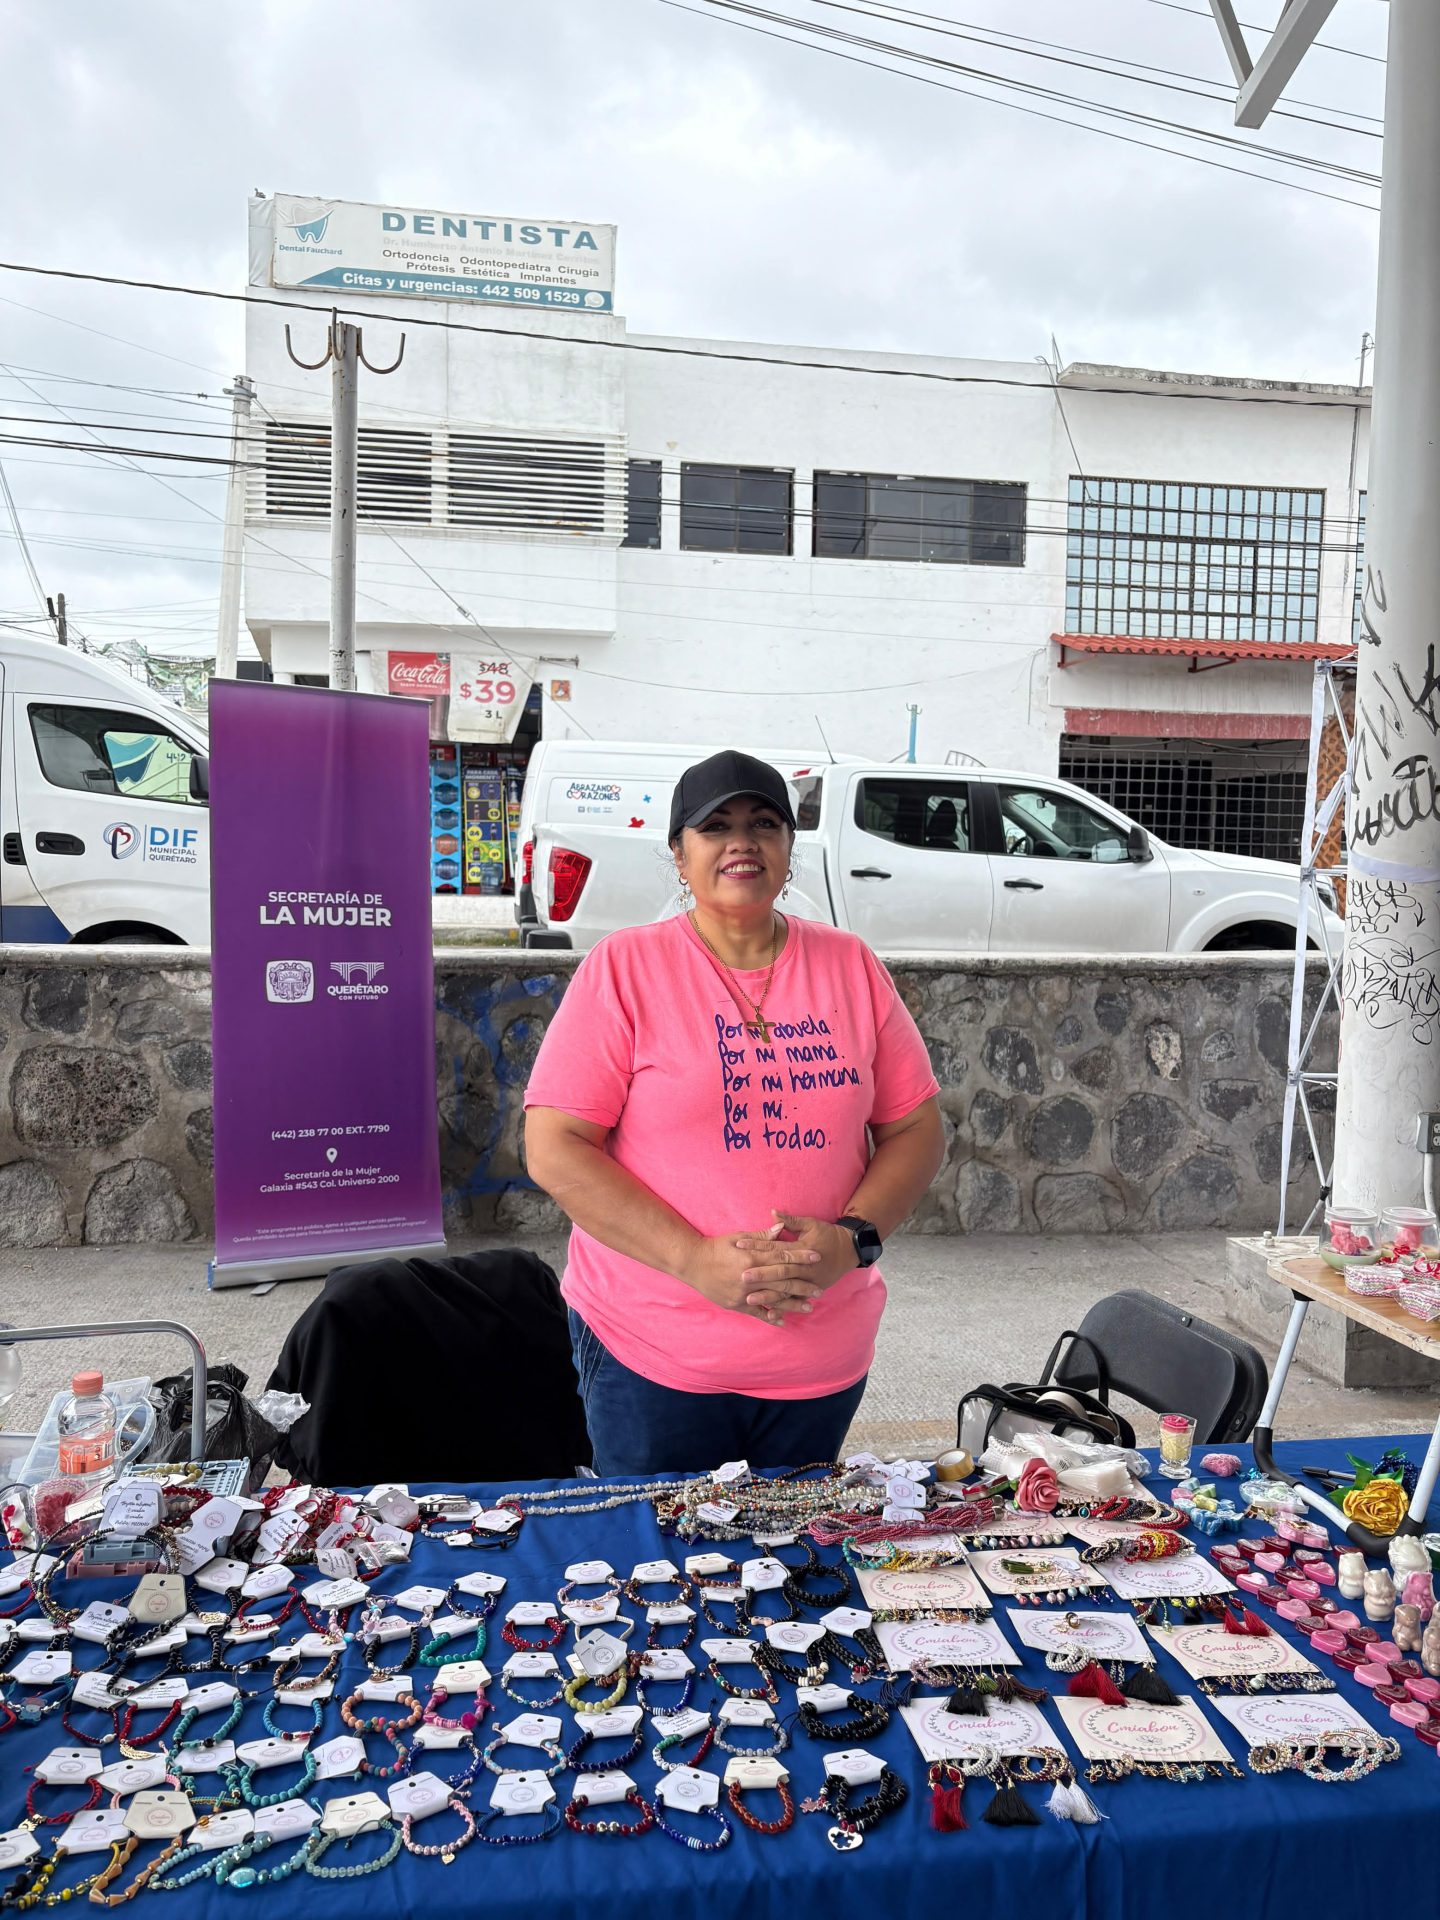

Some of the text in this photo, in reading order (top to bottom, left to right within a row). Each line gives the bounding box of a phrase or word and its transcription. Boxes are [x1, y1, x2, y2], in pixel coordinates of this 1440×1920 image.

[382, 212, 598, 250] DENTISTA
[279, 244, 343, 255] Dental Fauchard
[382, 249, 600, 277] Ortodoncia Odontopediatra Cirugia
[406, 261, 577, 285] Prótesis Estética Implantes
[342, 272, 580, 304] Citas y urgencias: 442 509 1529
[391, 662, 449, 684] Coca-Cola
[460, 679, 516, 704] $39
[485, 710, 503, 719] 3 L
[150, 826, 198, 848] DIF
[149, 847, 197, 856] MUNICIPAL
[268, 890, 383, 905] SECRETARÍA DE
[260, 905, 392, 926] LA MUJER
[327, 983, 389, 996] QUERÉTARO
[714, 1013, 743, 1041] Por
[718, 1040, 745, 1066] Por
[756, 1045, 776, 1063] mi
[722, 1064, 751, 1092] Por
[762, 1072, 783, 1092] mi
[724, 1093, 748, 1123] Por
[271, 1124, 390, 1141] (442) 238 77 00 EXT. 7790
[723, 1122, 750, 1152] Por
[259, 1174, 400, 1193] Galaxia #543 Col. Universo 2000
[284, 1165, 381, 1180] Secretaría de la Mujer
